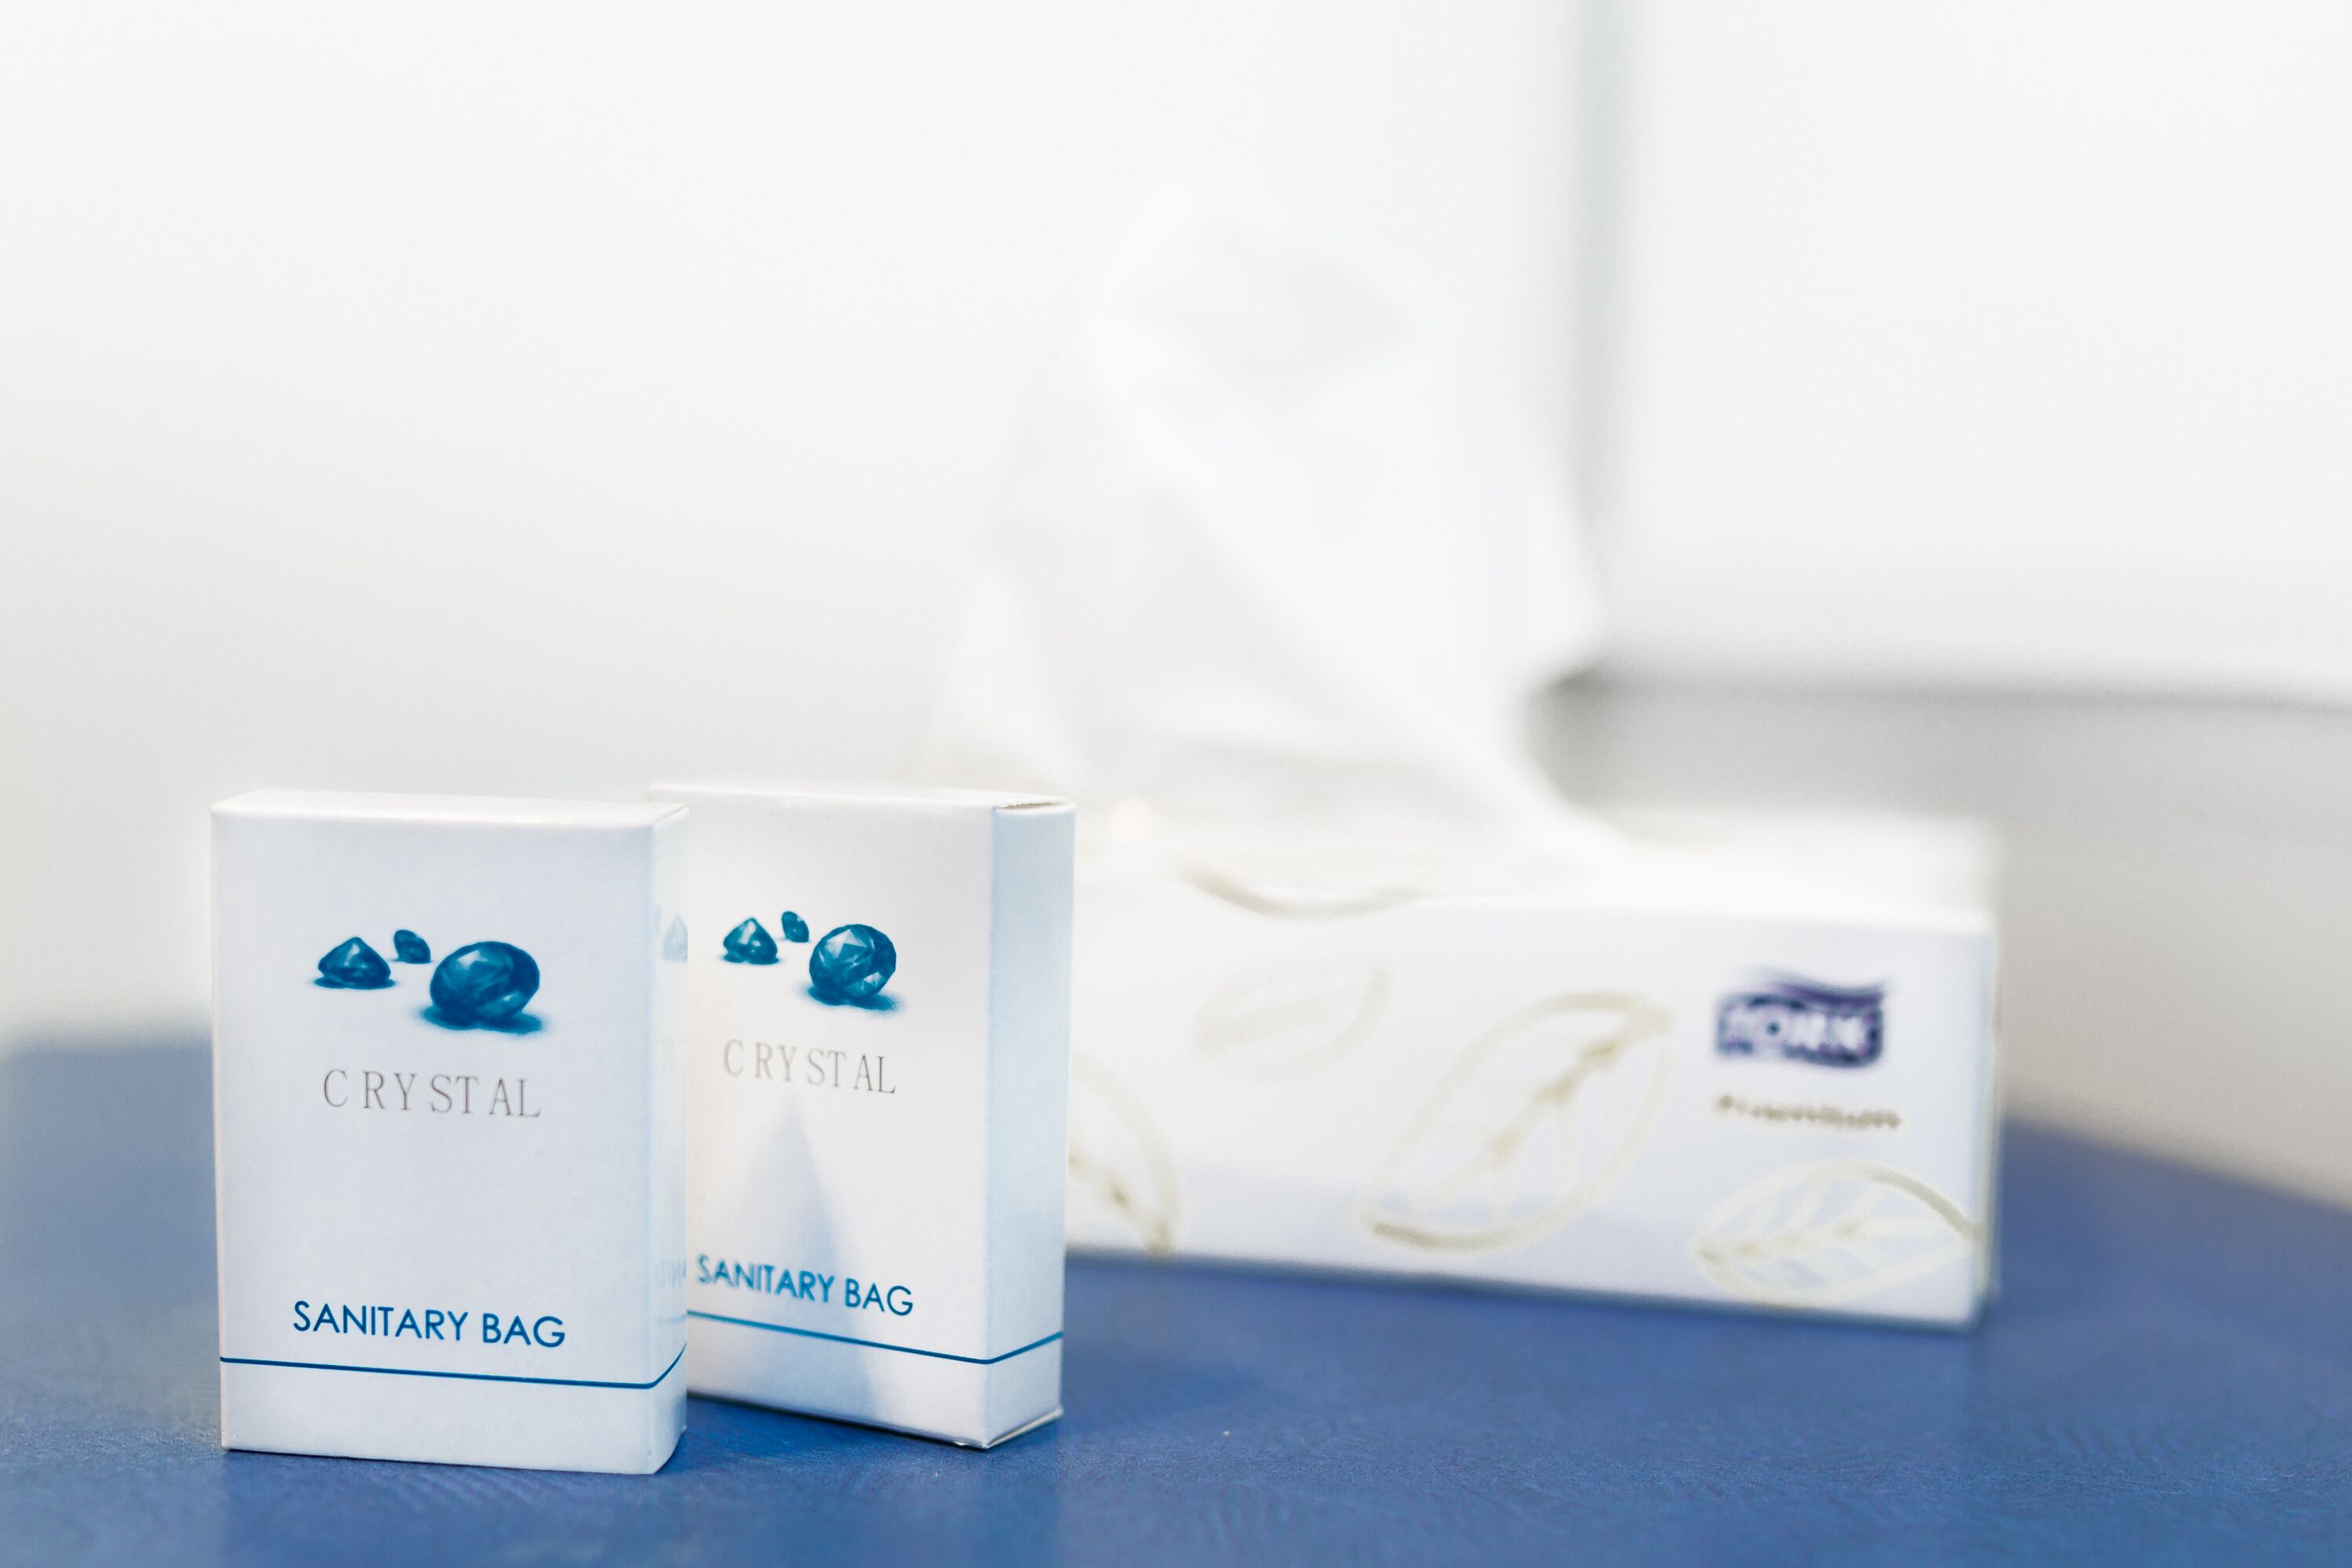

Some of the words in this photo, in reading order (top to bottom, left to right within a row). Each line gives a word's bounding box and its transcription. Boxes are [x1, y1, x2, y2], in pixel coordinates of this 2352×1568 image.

[323, 1068, 540, 1118] CRYSTAL
[723, 1040, 897, 1094] CRYSTAL
[697, 1254, 837, 1305] SANITARY
[844, 1276, 914, 1317] BAG
[292, 1300, 470, 1342] SANITARY
[481, 1312, 566, 1349] BAG
